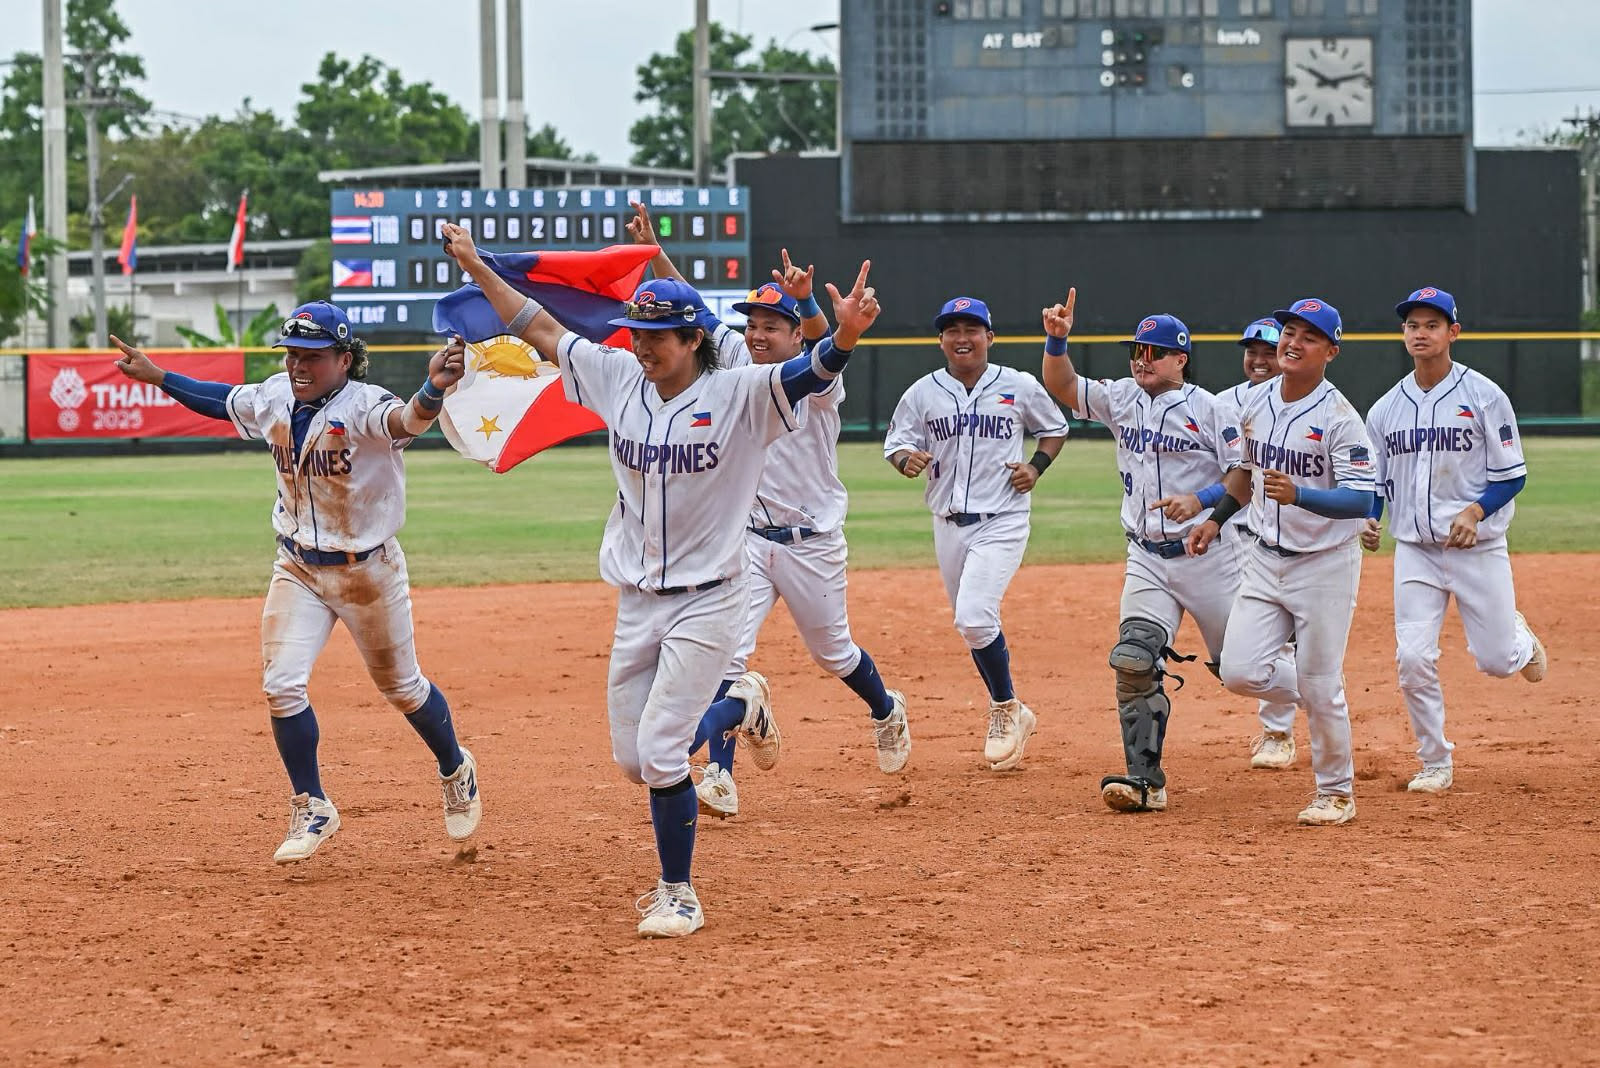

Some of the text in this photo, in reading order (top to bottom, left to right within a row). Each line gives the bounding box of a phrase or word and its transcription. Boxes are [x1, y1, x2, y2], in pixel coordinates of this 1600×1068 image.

[983, 33, 1043, 48] AT BAT
[1217, 29, 1260, 45] km/h
[415, 190, 422, 208] 1
[436, 190, 448, 208] 2
[461, 190, 472, 208] 3
[485, 190, 496, 208] 4
[557, 190, 568, 207] 7
[728, 188, 739, 206] E
[411, 218, 424, 240] 0
[483, 217, 496, 239] 0
[507, 217, 520, 239] 0
[531, 217, 545, 239] 2
[555, 216, 568, 238] 0
[581, 217, 590, 238] 1
[602, 217, 616, 238] 0
[659, 216, 672, 237] 3
[415, 262, 423, 283] 1
[436, 262, 449, 283] 0
[726, 259, 739, 279] 2
[1417, 288, 1437, 300] P
[954, 300, 970, 312] P
[1296, 301, 1321, 314] P
[1137, 320, 1156, 340] P
[92, 384, 177, 407] THAIL
[93, 409, 142, 430] 2025
[1119, 425, 1201, 454] PHILPPINE
[1386, 427, 1473, 458] PHILIPPINES
[613, 429, 719, 474] PHILIPPINES
[1245, 437, 1324, 478] ILIPPINES
[1119, 471, 1133, 497] 9
